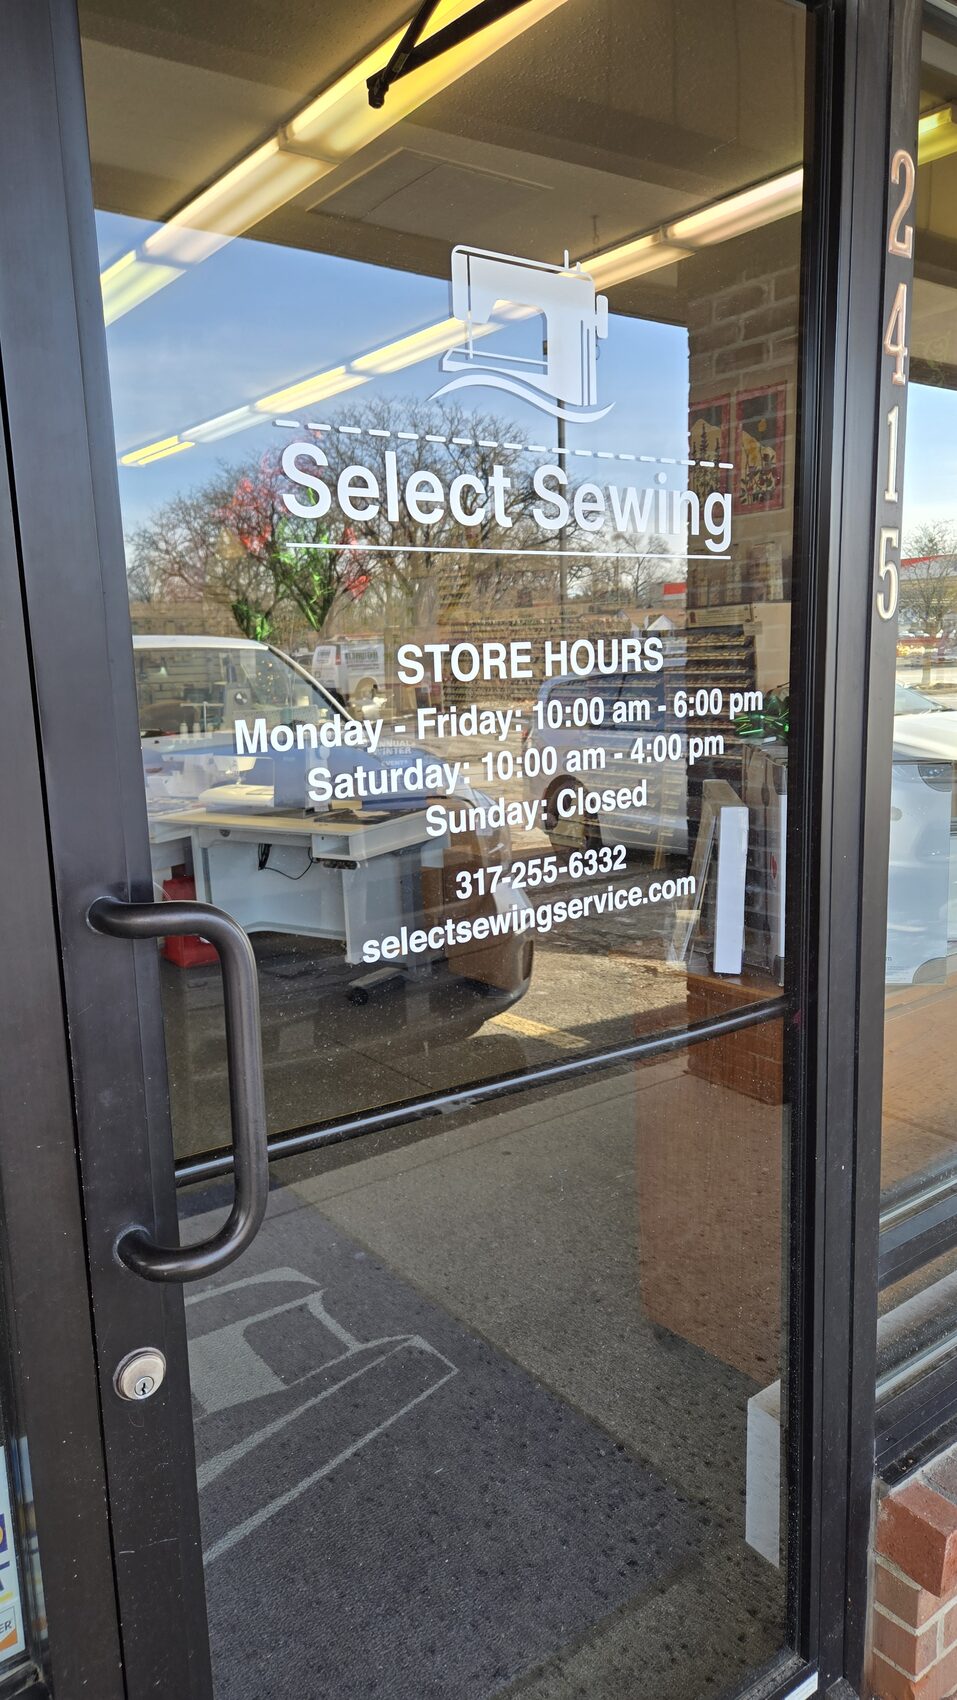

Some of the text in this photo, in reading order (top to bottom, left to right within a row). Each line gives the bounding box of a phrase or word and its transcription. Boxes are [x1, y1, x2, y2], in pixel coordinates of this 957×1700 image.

[875, 148, 916, 621] 2415
[281, 442, 733, 553] Select Sewing
[397, 642, 533, 685] STORE
[545, 637, 664, 677] HOURS
[234, 714, 383, 755] Monday
[417, 705, 523, 741] Friday:
[532, 696, 605, 730] 10:00
[612, 699, 650, 724] am
[673, 688, 723, 719] 6:00
[729, 690, 764, 722] pm
[307, 758, 471, 802] Saturday:
[481, 746, 558, 782] 10:00
[566, 747, 606, 773] am
[630, 733, 683, 765] 4:00
[688, 735, 725, 766] pm
[425, 779, 648, 837] Sunday: Closed
[455, 844, 628, 901] 317-255-6332
[362, 873, 697, 963] selectsewingservice.com
